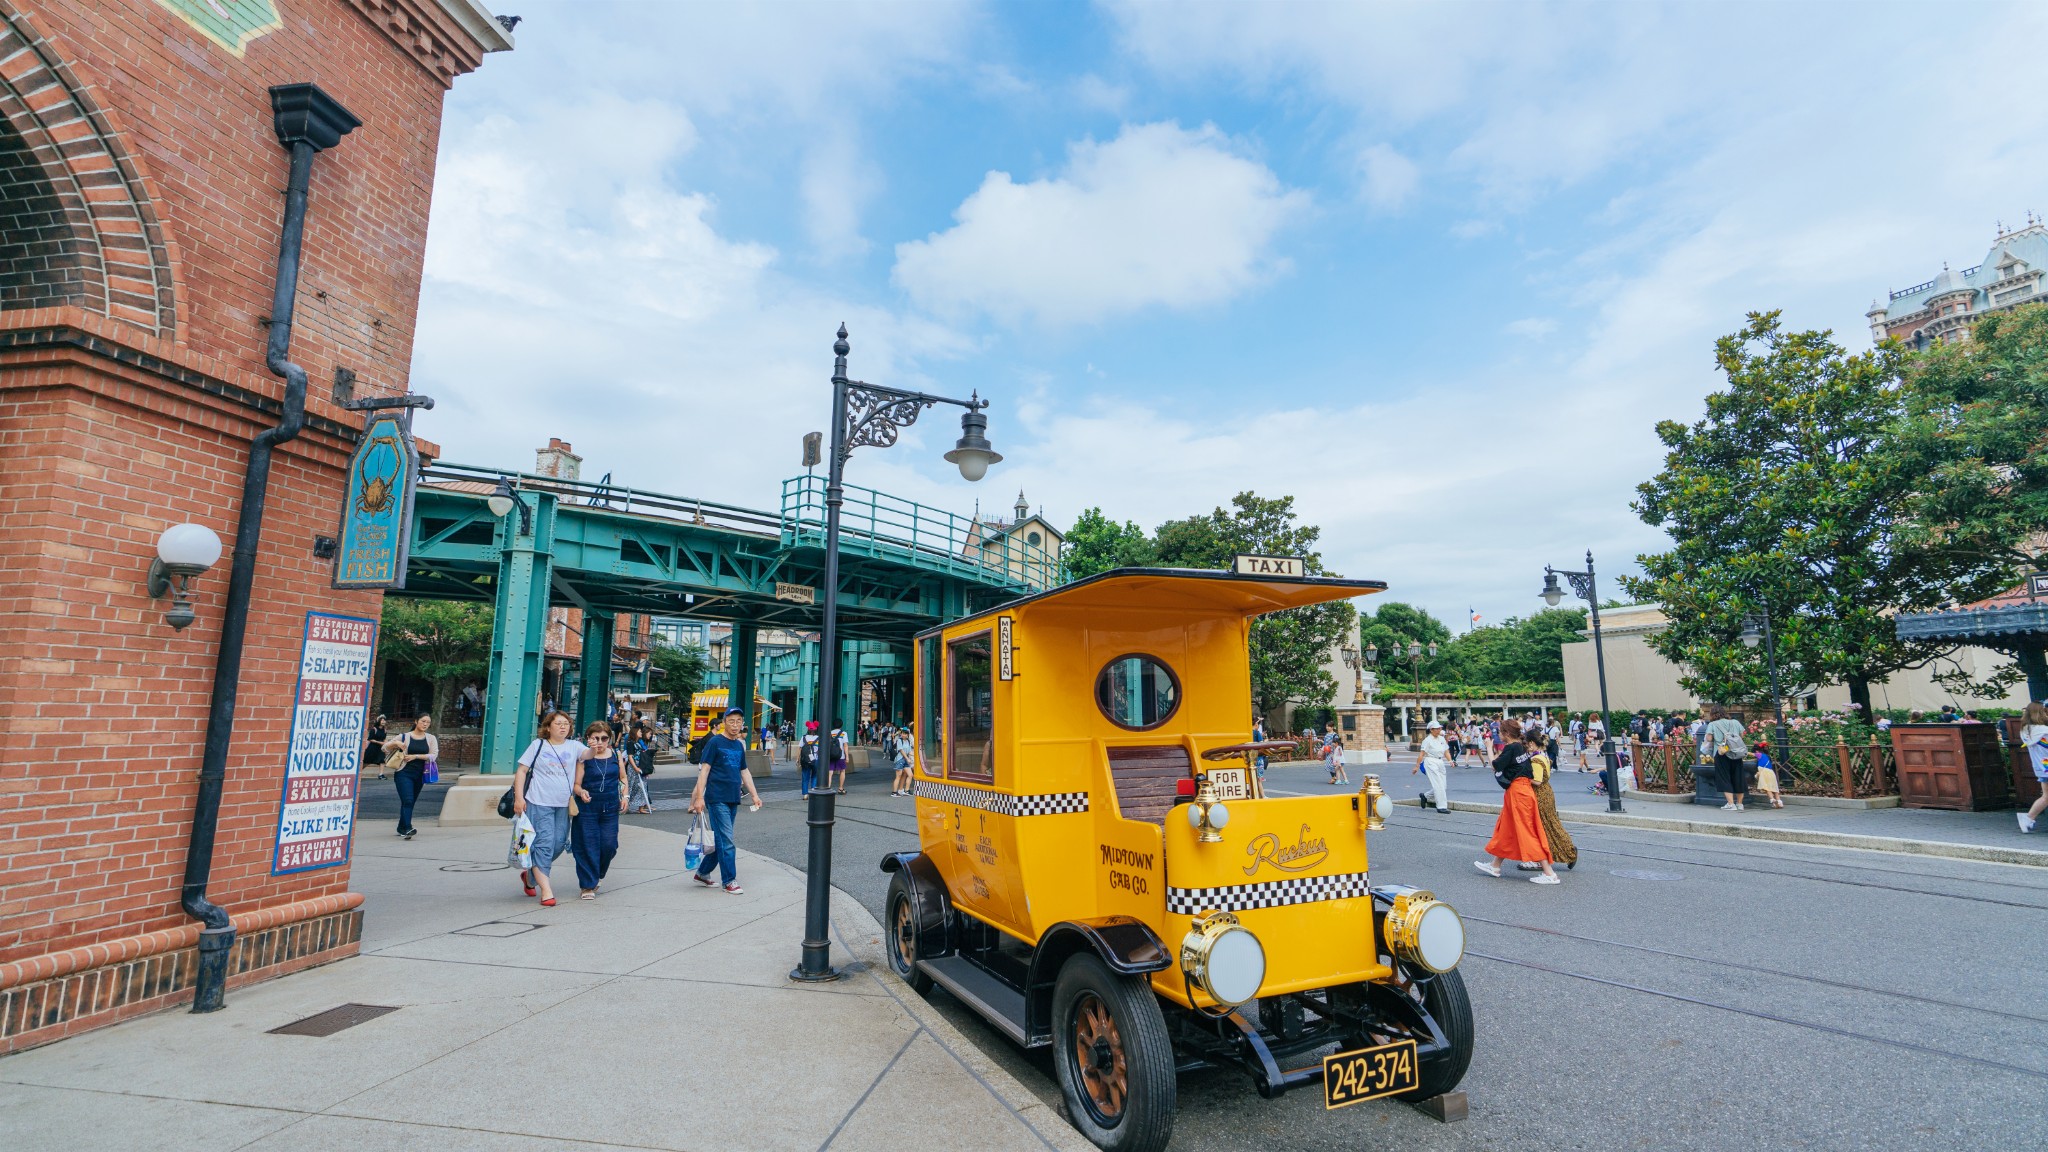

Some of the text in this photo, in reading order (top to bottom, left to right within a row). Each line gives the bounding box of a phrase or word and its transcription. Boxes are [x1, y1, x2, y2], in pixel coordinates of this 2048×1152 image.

[348, 548, 390, 560] FRESH
[346, 562, 388, 578] FISH
[1248, 559, 1292, 574] TAXI
[778, 585, 812, 600] HEADROOM
[314, 618, 370, 632] RESTAURANT
[312, 627, 368, 643] SAKURA
[314, 658, 360, 675] SLAP IT
[305, 682, 362, 692] RESTAURANT
[304, 690, 360, 703] SAKURA
[300, 710, 360, 730] VEGETABLES
[292, 751, 355, 772] NOODLES
[292, 778, 350, 788] RESTAURANT
[1216, 772, 1238, 784] FOR
[290, 785, 349, 800] SAKURA
[1216, 786, 1242, 797] HIRE
[292, 817, 341, 836] LIKE IT
[284, 838, 343, 854] RESTAURANT
[1242, 823, 1329, 876] Ruckus
[282, 847, 342, 866] SAKURA
[1100, 844, 1154, 870] MIDTOWN
[1110, 870, 1150, 896] CAB CO.
[1331, 1049, 1412, 1100] 242-374
